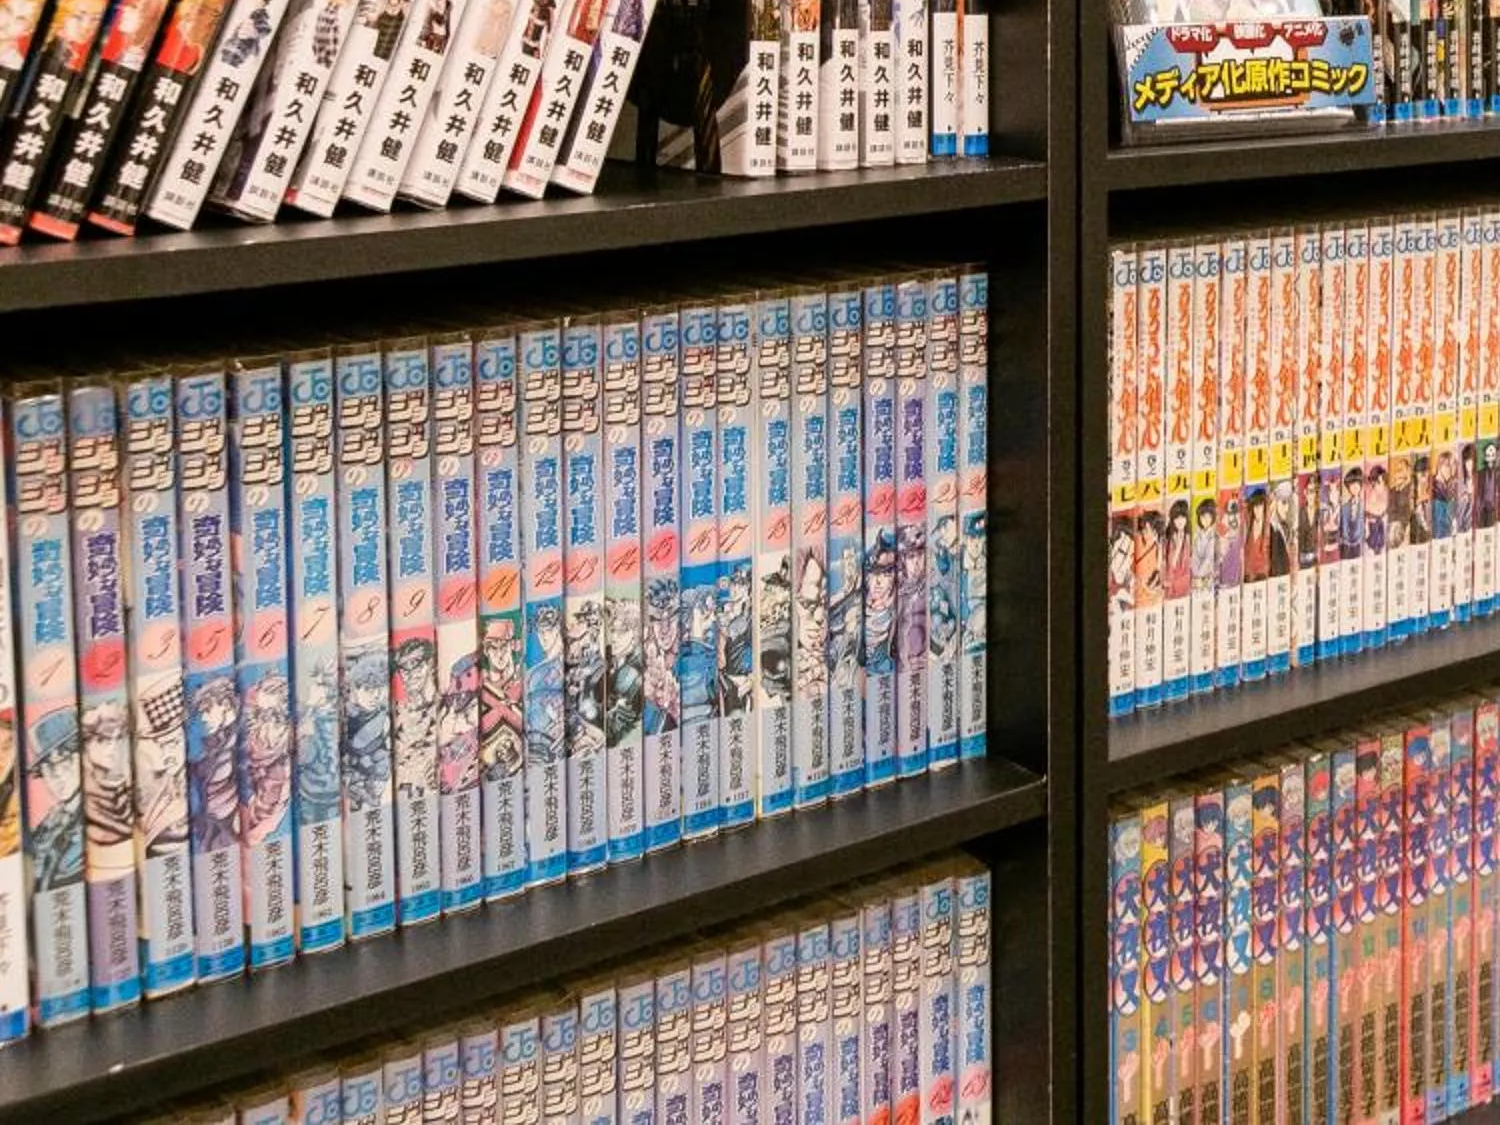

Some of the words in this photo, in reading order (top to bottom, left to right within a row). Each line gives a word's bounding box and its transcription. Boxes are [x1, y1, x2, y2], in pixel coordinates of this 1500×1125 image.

[263, 71, 319, 179] 和久井健
[324, 64, 377, 169] 和久井健
[380, 58, 431, 162] 和久井健
[435, 62, 485, 165] 和久井健
[483, 63, 531, 165] 和久井健
[538, 49, 583, 150] 和久井健
[586, 46, 630, 144] 和久井健
[755, 52, 775, 146] 和久井健
[796, 42, 814, 136] 和久井健
[839, 40, 855, 132] 和久井健
[874, 42, 890, 132] 和久井健
[907, 39, 923, 128] 和久井健
[1134, 56, 1368, 111] メディア化原作コミック
[4, 74, 67, 191] 和久井健
[64, 74, 127, 188] 和久井健
[117, 76, 182, 188] 和久井健
[180, 76, 241, 184] 和久井健
[718, 524, 748, 555] 17
[302, 607, 330, 640] 7
[358, 596, 381, 624] 8
[404, 588, 426, 618] 9
[445, 579, 475, 613] 10
[487, 572, 518, 602] 11
[41, 656, 65, 686] 1
[147, 631, 175, 659] 3
[196, 627, 226, 660] 5
[257, 621, 283, 650] 6
